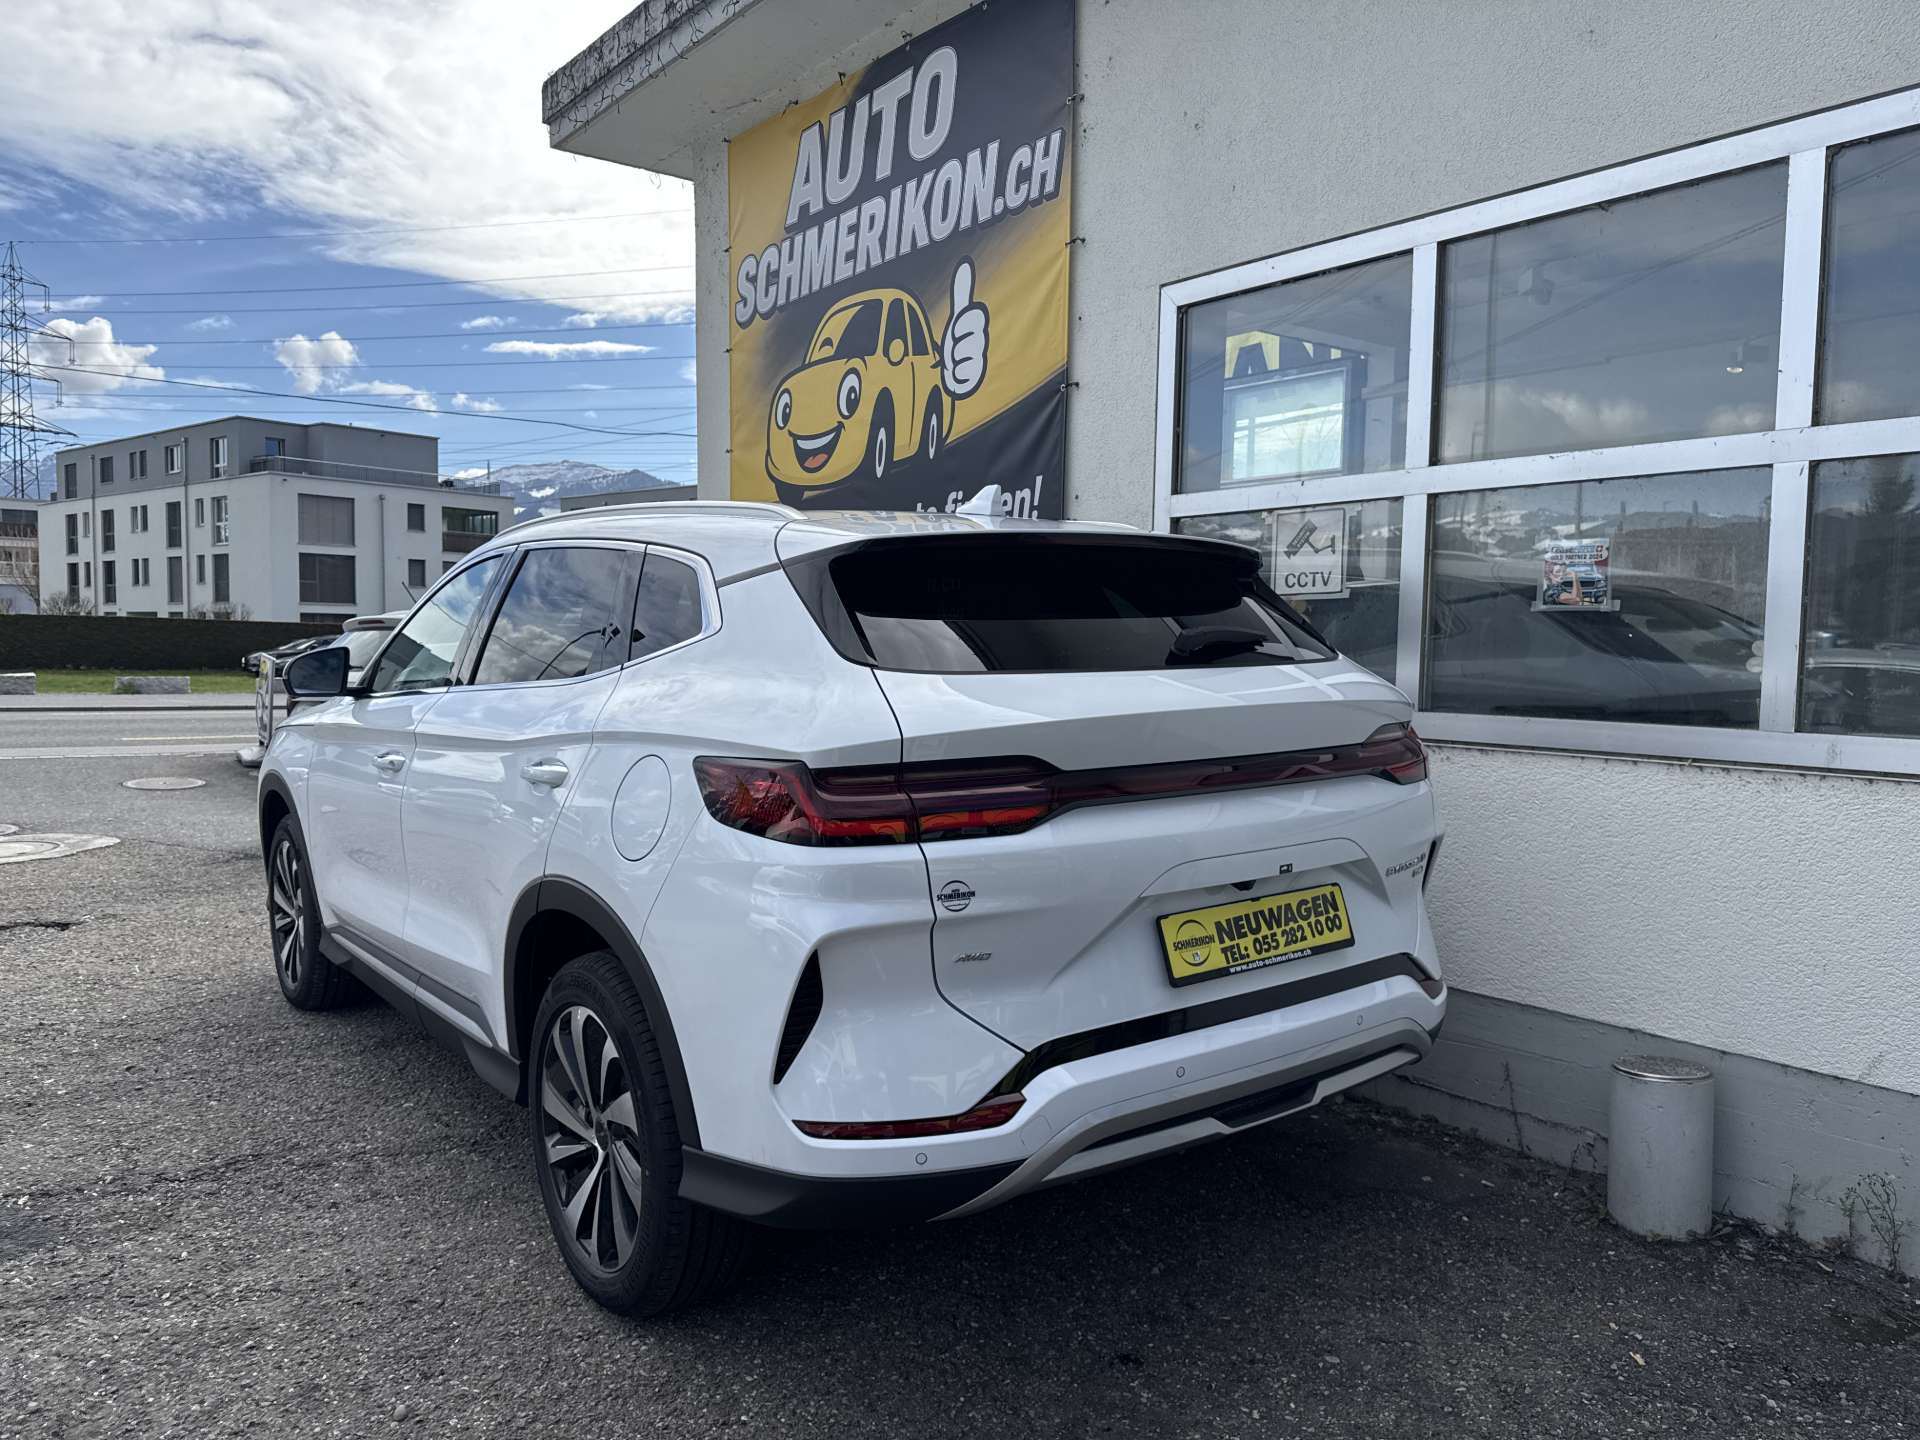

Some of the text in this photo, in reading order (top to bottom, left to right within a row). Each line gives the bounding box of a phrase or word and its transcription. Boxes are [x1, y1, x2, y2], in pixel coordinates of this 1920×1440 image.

[786, 45, 958, 228] AUTO
[735, 129, 1063, 328] SCHMERIKON.CH
[1285, 571, 1331, 588] CCTV
[937, 890, 975, 901] SCHMERIKON
[1214, 891, 1340, 944] NEUWAGEN
[1173, 934, 1215, 951] SCHMERIKON
[1221, 913, 1343, 965] TEL: 055 282 10 00
[1229, 949, 1312, 973] www.auto-schmerikon.ch
